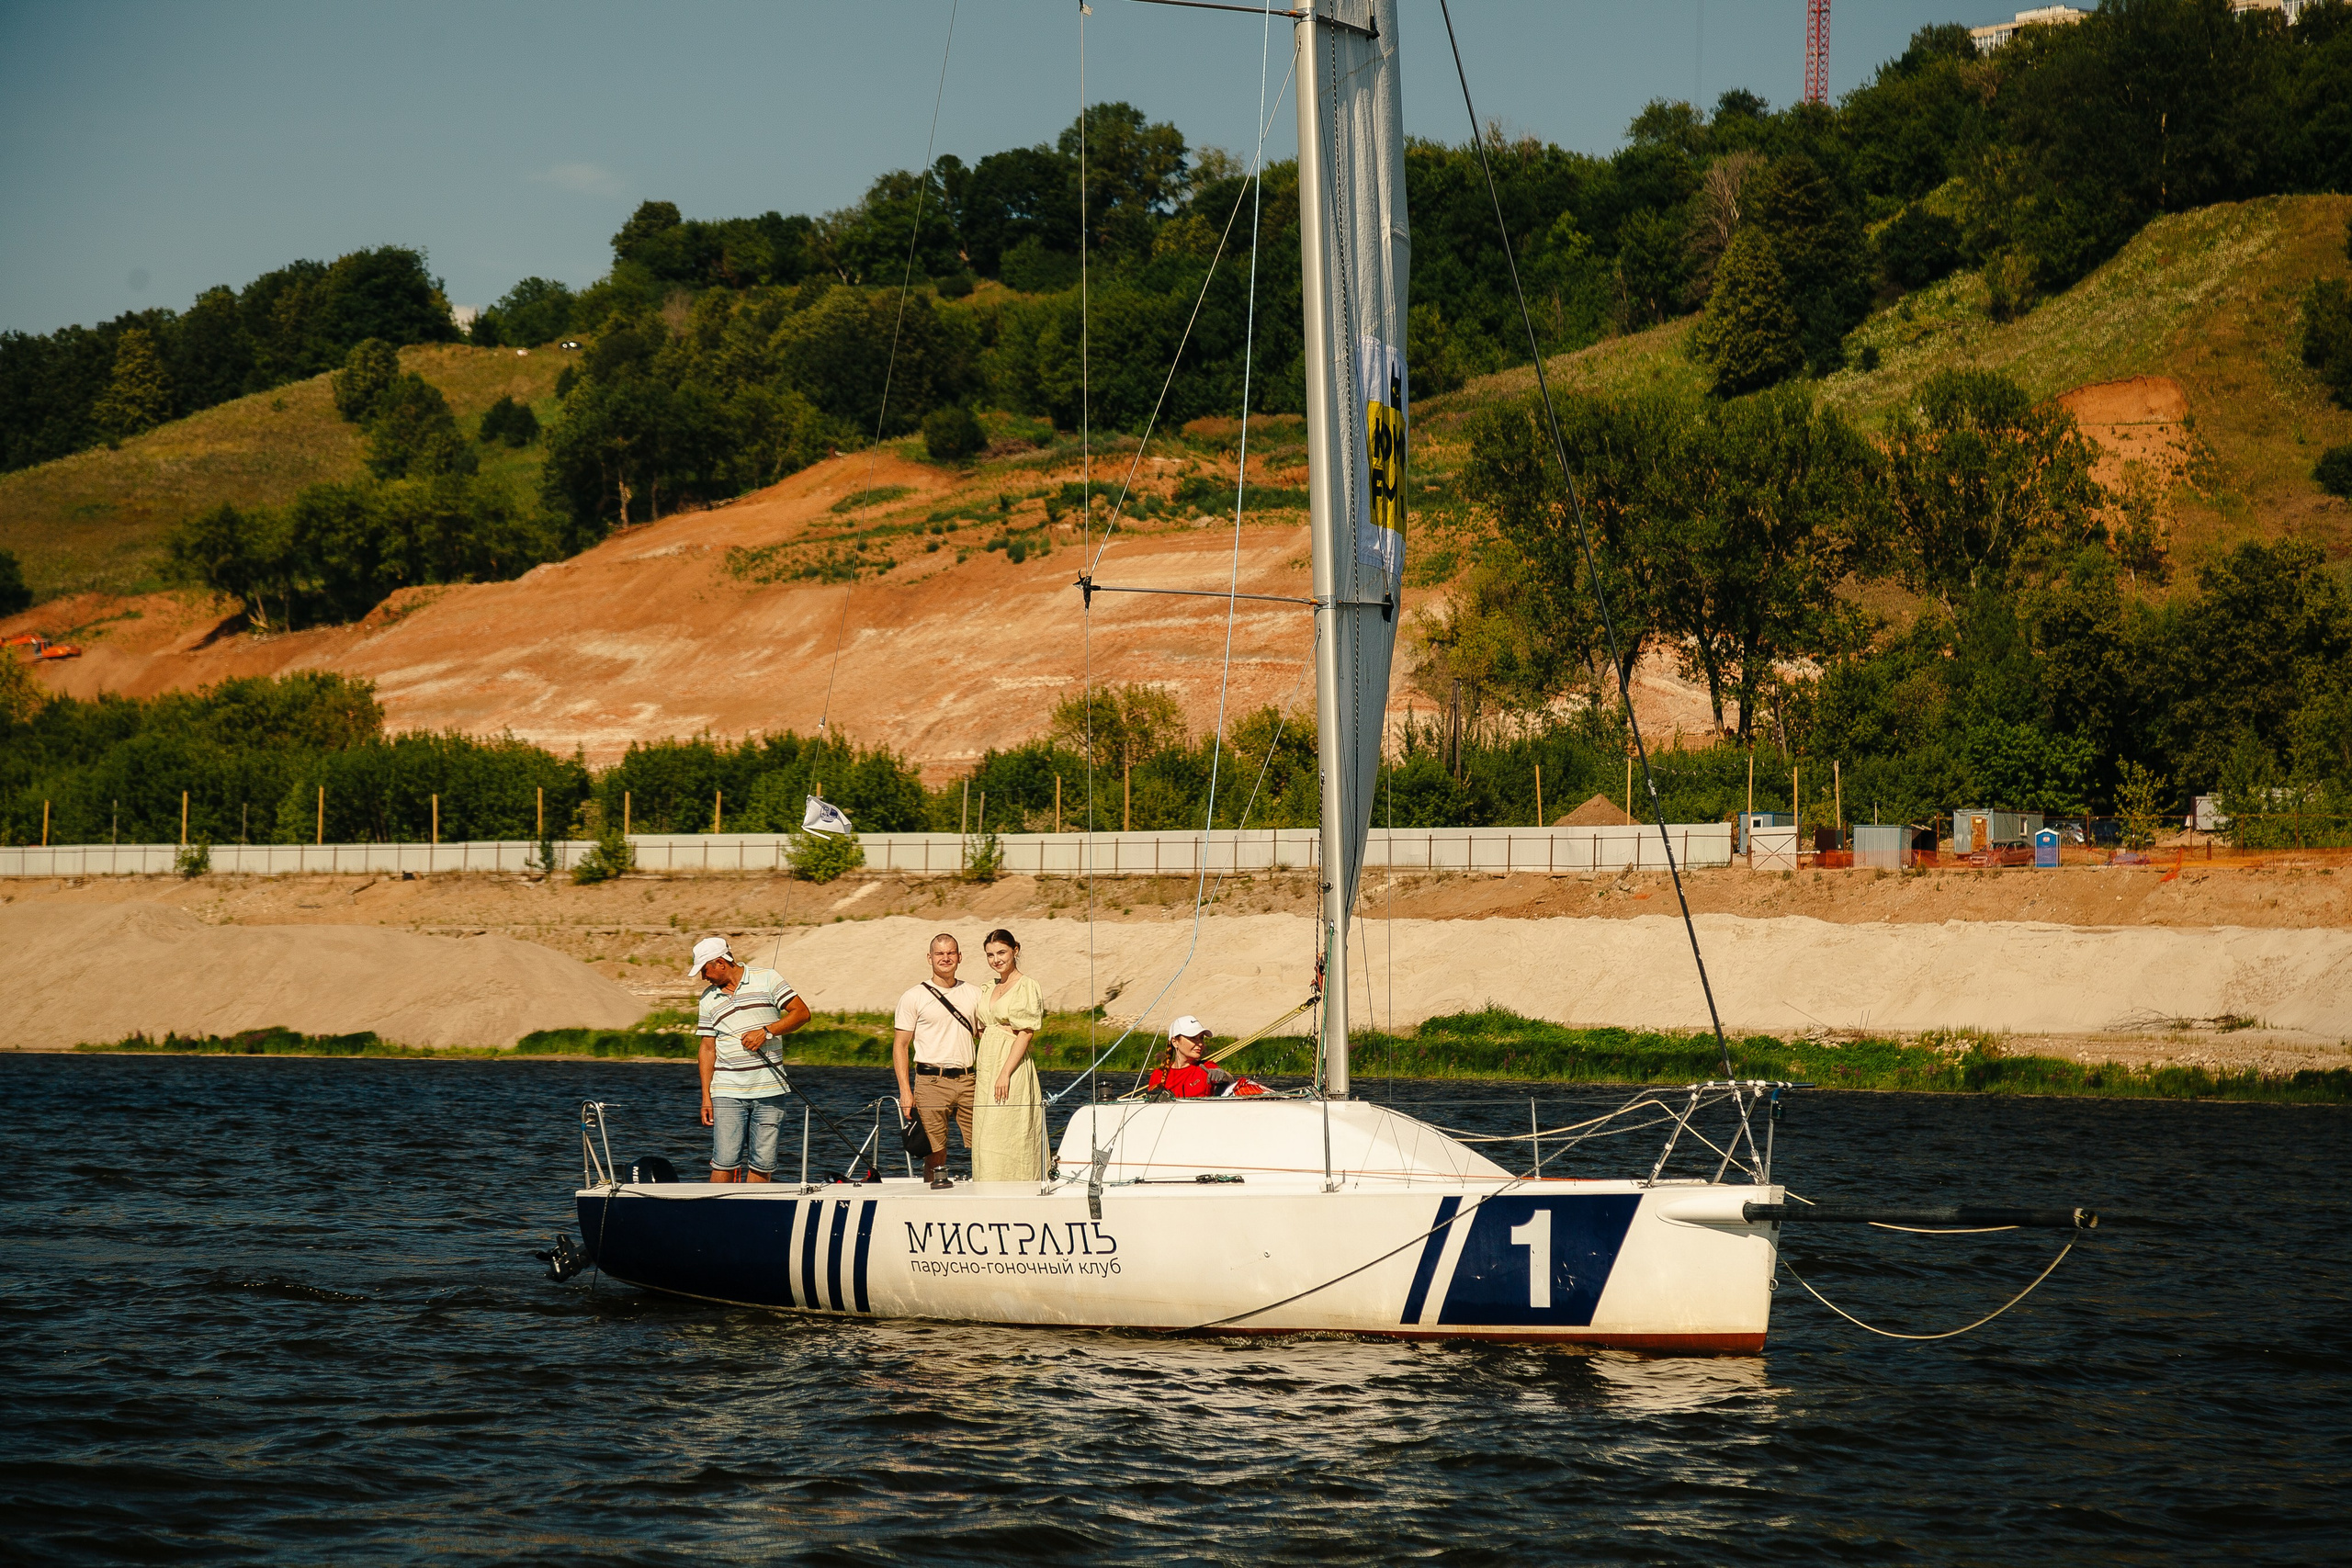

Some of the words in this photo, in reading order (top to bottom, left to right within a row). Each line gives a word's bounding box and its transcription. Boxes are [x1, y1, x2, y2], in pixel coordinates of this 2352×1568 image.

[904, 1221, 1117, 1256] МИСТРАЛЬ
[910, 1258, 1074, 1277] парусно-гоночный
[1079, 1257, 1122, 1278] клуб
[1510, 1209, 1551, 1308] 1
